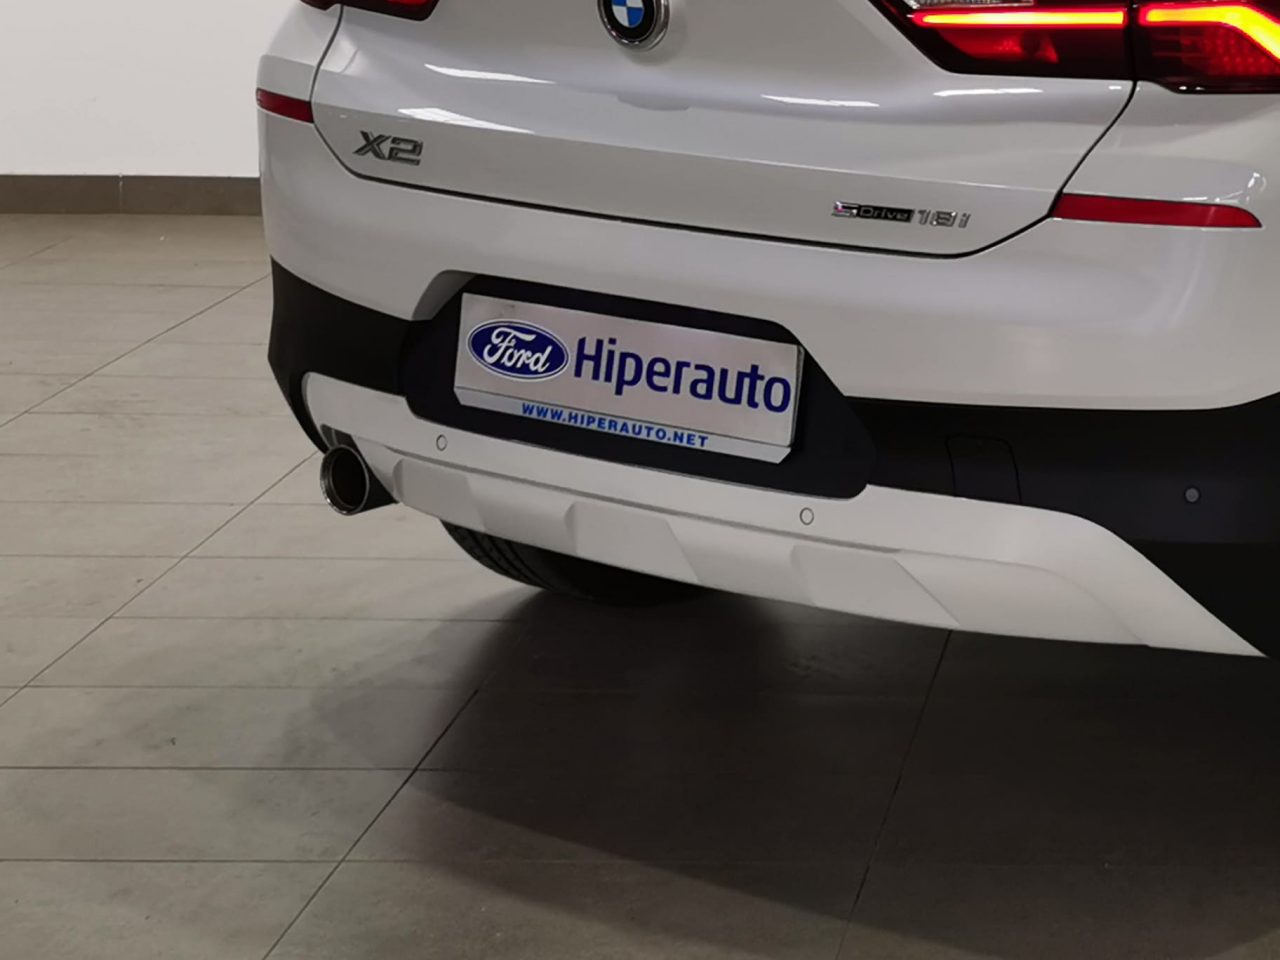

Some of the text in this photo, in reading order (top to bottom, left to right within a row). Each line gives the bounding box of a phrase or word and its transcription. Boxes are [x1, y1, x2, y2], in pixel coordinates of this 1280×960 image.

[352, 129, 424, 167] X2
[482, 326, 553, 374] Ford
[573, 336, 793, 413] Hiperauto
[520, 402, 710, 448] WWW.HIPERAUTO.NET
